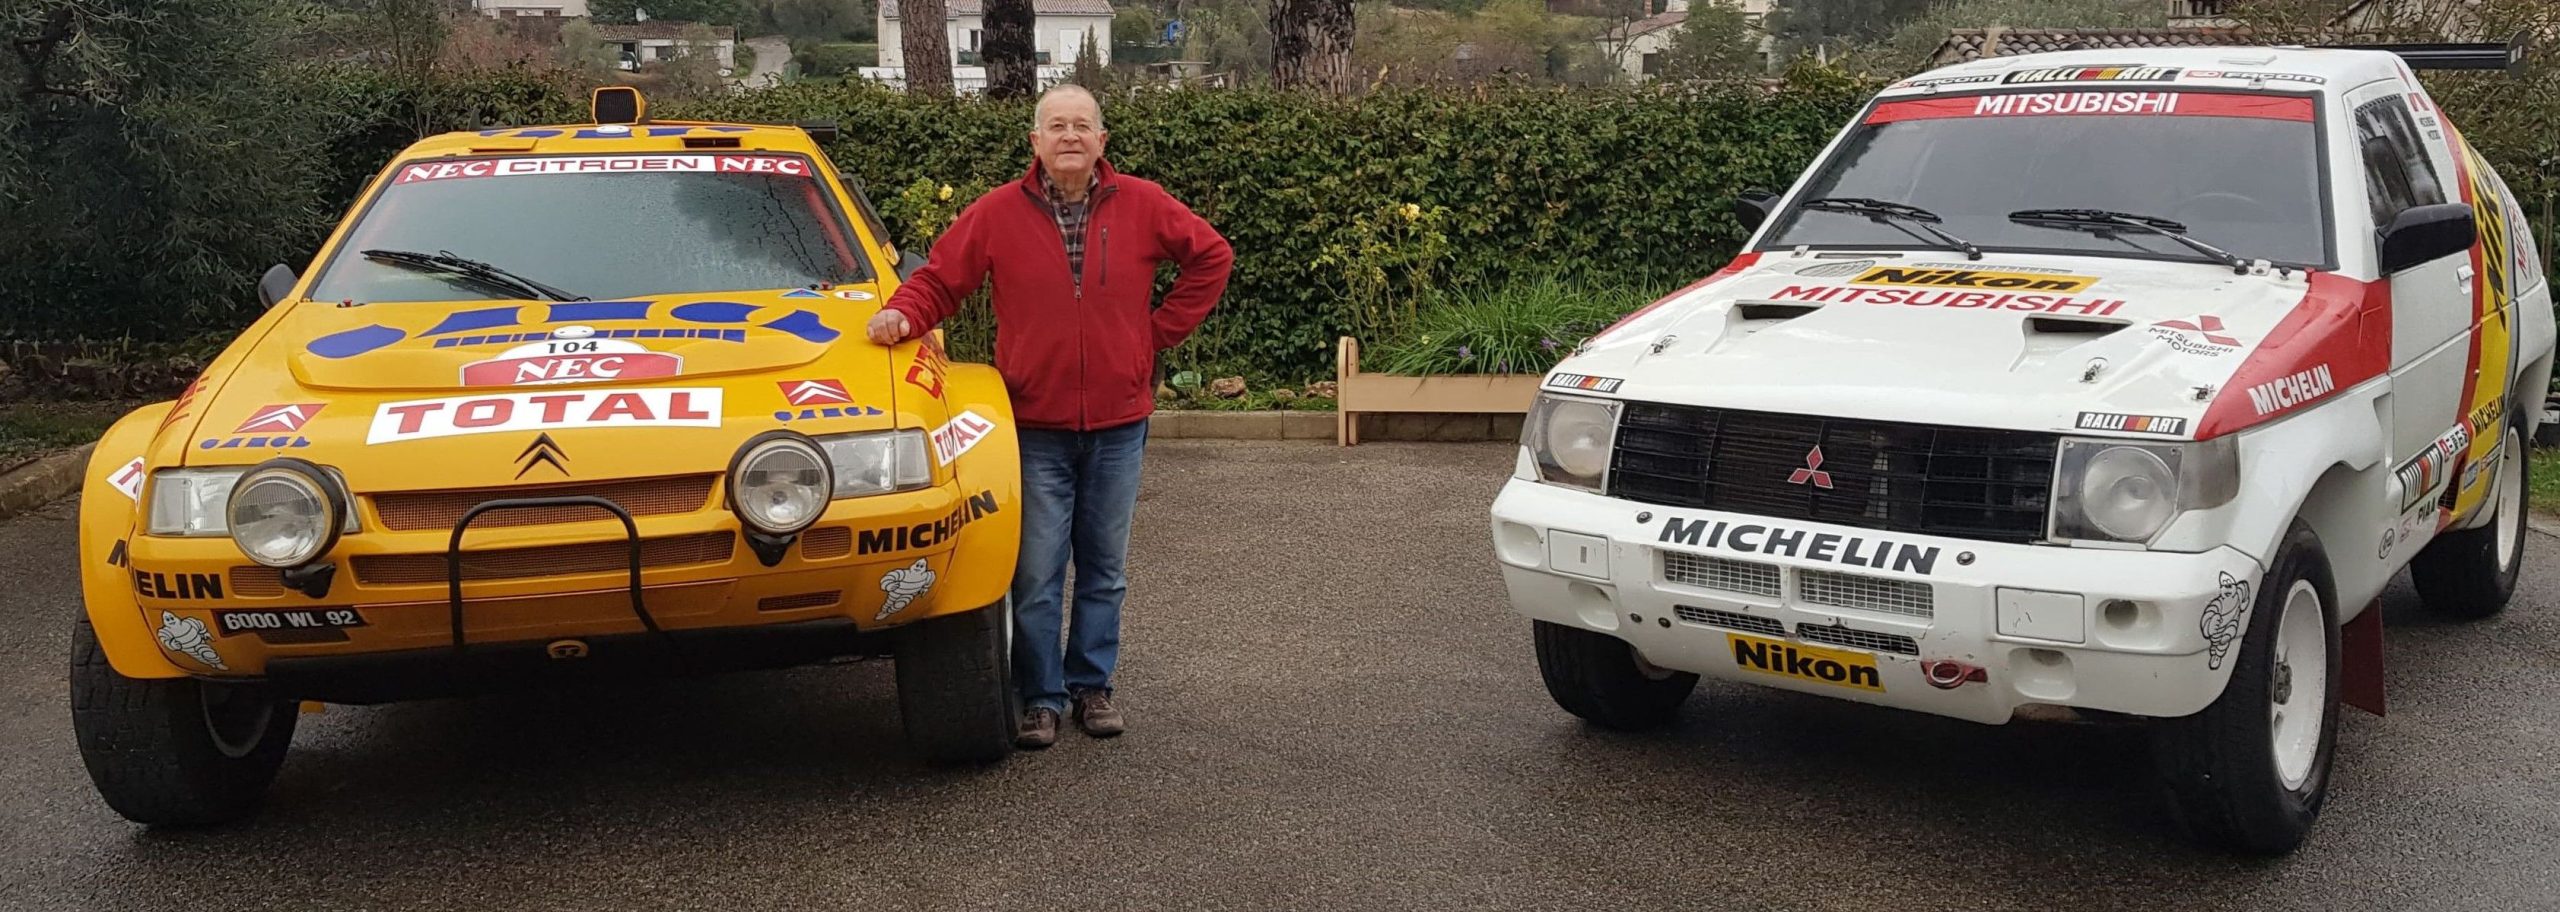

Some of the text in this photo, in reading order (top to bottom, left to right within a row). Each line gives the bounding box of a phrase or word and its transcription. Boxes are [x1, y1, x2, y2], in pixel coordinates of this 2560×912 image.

[1974, 91, 2179, 115] MITSUBISHI
[403, 157, 802, 182] NEC CITROEN NEC
[1863, 268, 2079, 290] Nikon
[1769, 286, 2126, 315] MITSUBISHI
[547, 341, 599, 353] 104
[2148, 327, 2234, 354] MITSUBISHI
[2155, 334, 2220, 357] MOTORS
[514, 356, 625, 384] NEC
[2247, 363, 2335, 416] MICHELIN
[386, 392, 710, 434] TOTAL
[2080, 412, 2182, 433] RALLI ART
[858, 490, 1000, 555] MICHELIN
[1658, 517, 1941, 575] MICHELIN
[223, 610, 358, 630] 6000 WL 92
[1734, 639, 1880, 688] Nikon
